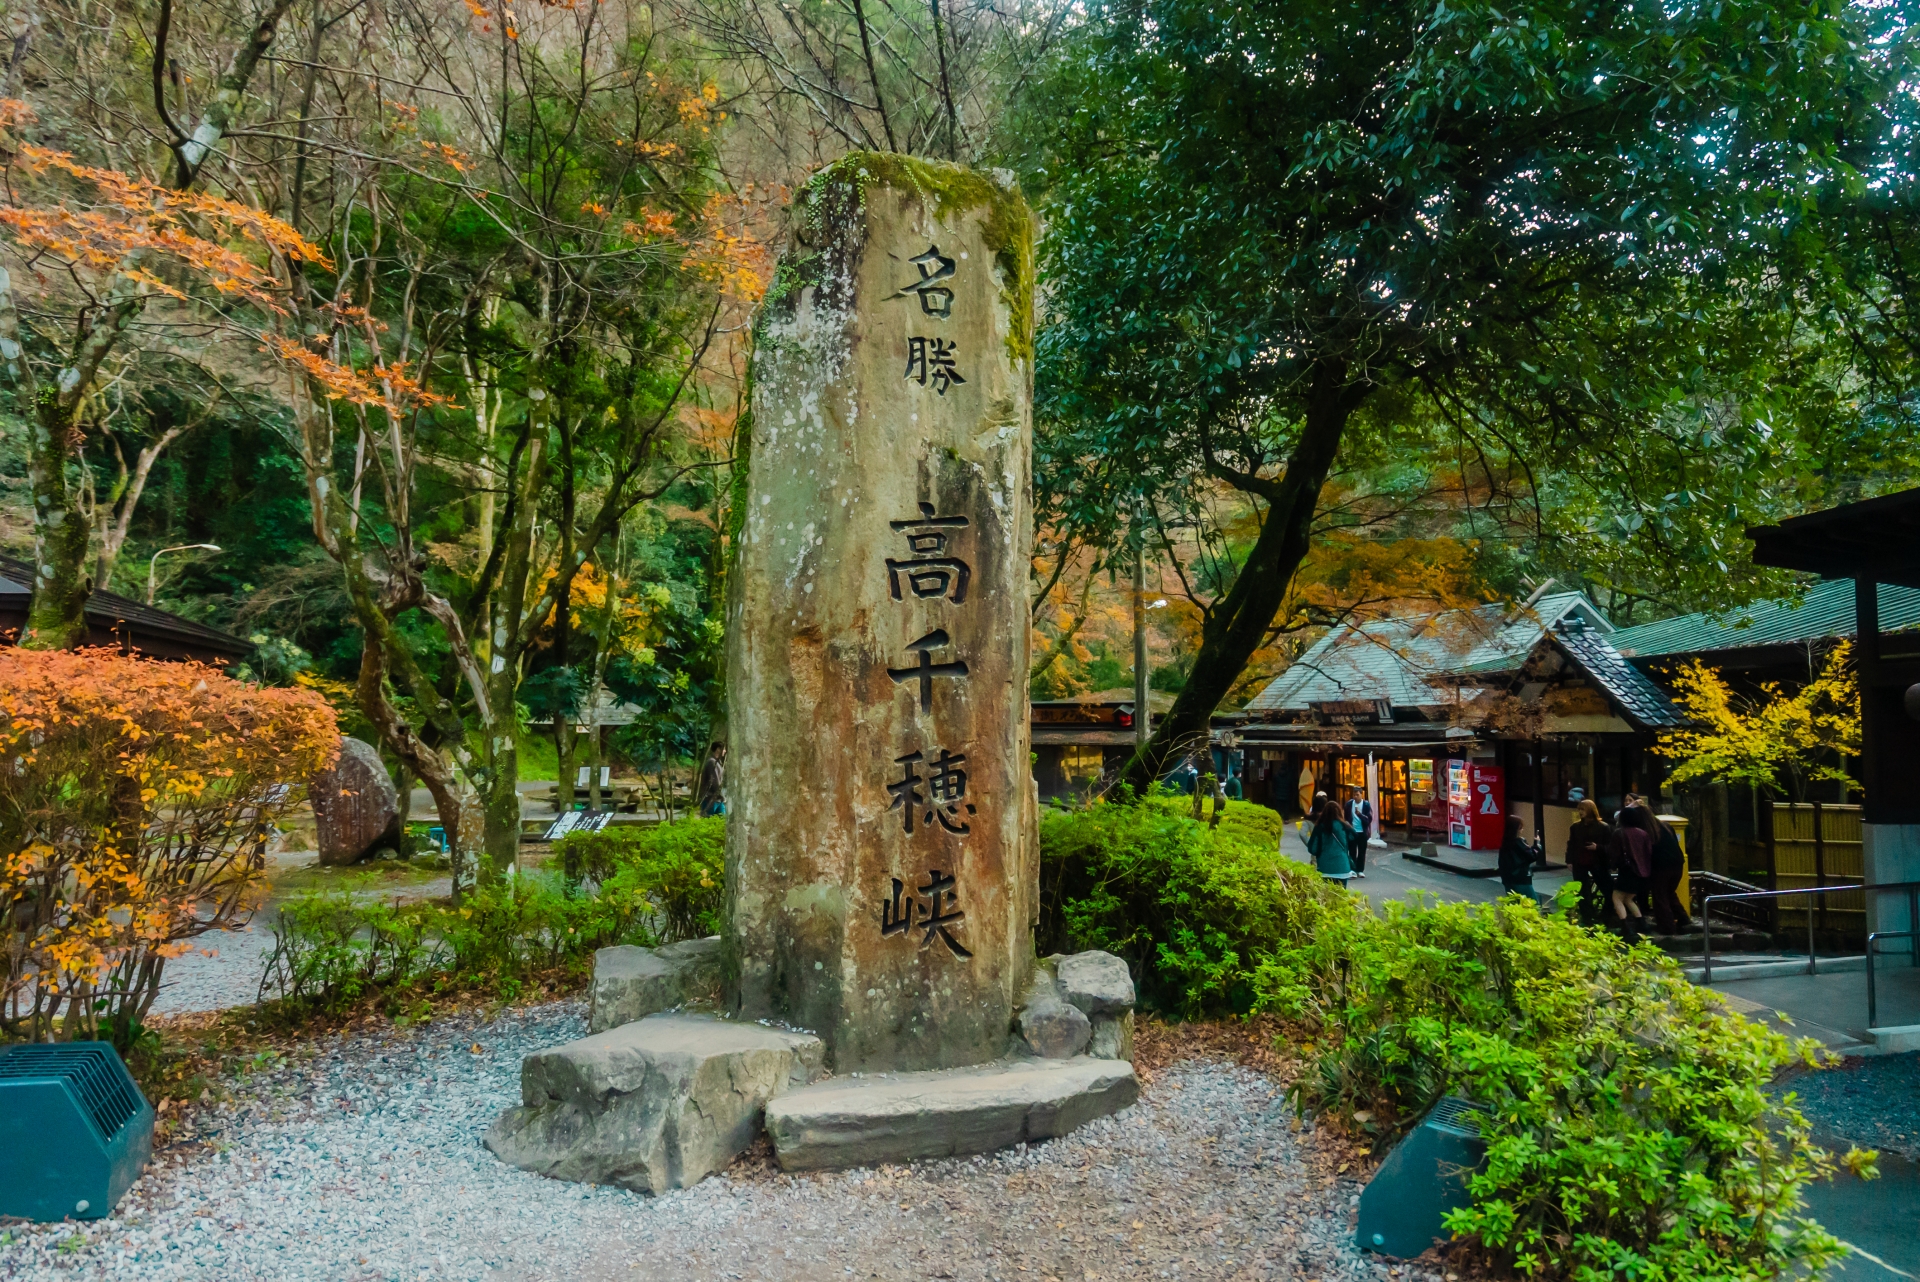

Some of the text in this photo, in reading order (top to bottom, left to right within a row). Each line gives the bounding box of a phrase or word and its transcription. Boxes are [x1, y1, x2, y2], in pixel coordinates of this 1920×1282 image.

[881, 244, 976, 963] 名勝 高千穂峡
